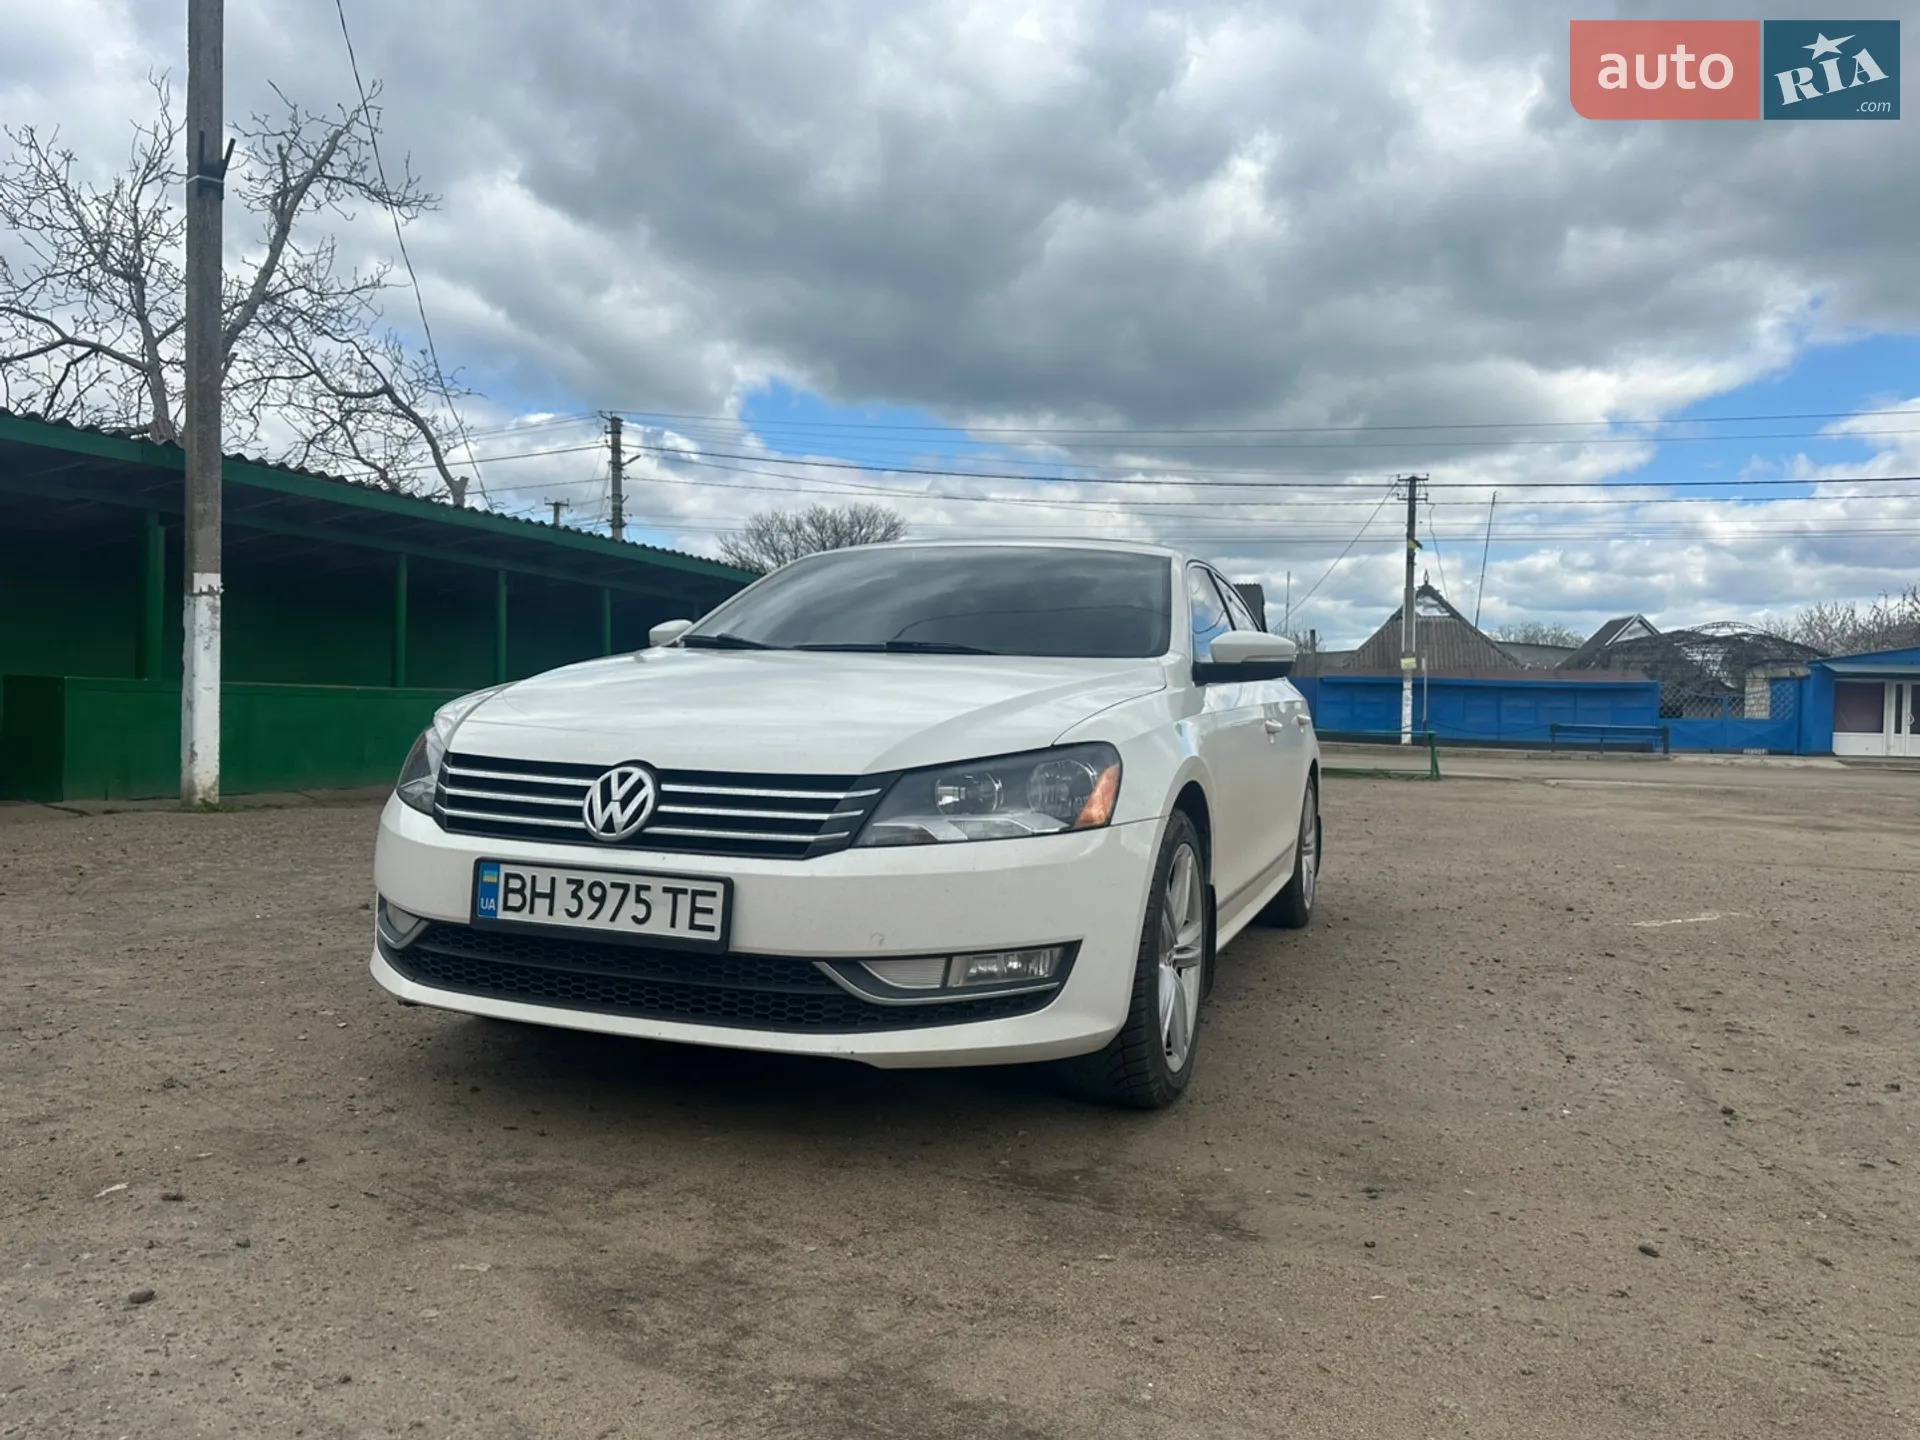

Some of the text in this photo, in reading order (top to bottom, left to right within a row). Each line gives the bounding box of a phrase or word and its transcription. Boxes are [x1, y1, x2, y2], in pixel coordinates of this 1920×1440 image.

[480, 896, 496, 911] UA
[502, 872, 718, 933] BH 3975 TE
